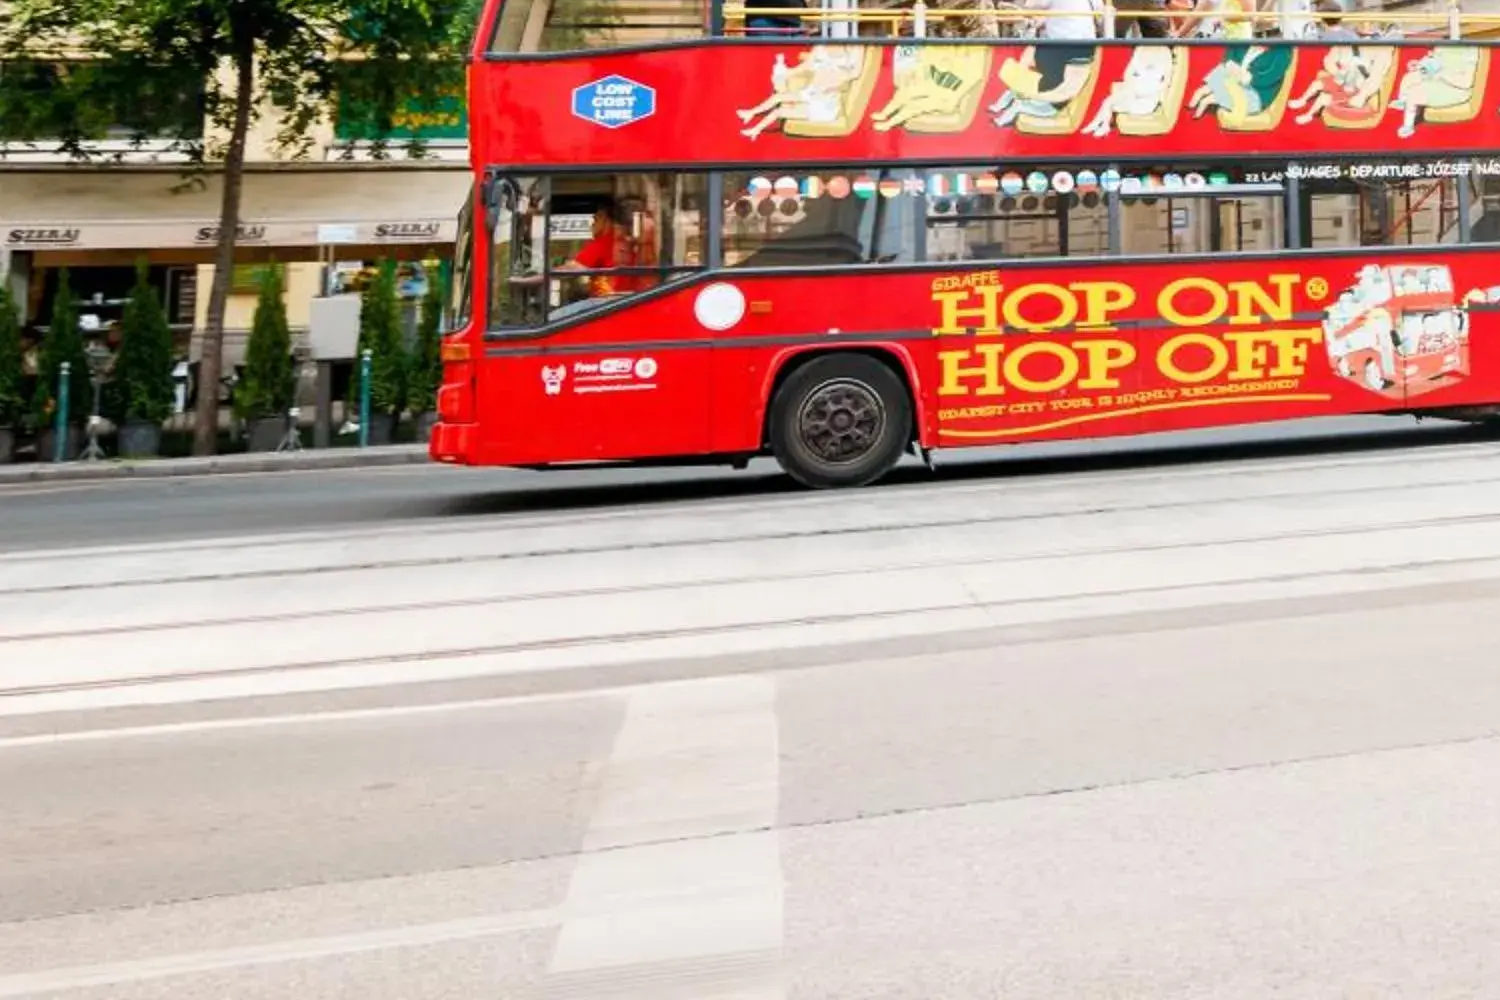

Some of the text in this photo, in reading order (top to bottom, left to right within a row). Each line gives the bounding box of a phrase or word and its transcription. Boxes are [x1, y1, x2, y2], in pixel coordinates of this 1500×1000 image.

[596, 84, 634, 95] LOW
[592, 96, 637, 107] COST
[595, 109, 633, 120] LINE
[932, 271, 1000, 290] GIRAFFE
[932, 273, 1301, 336] HOP ON
[938, 327, 1324, 396] HOP OFF
